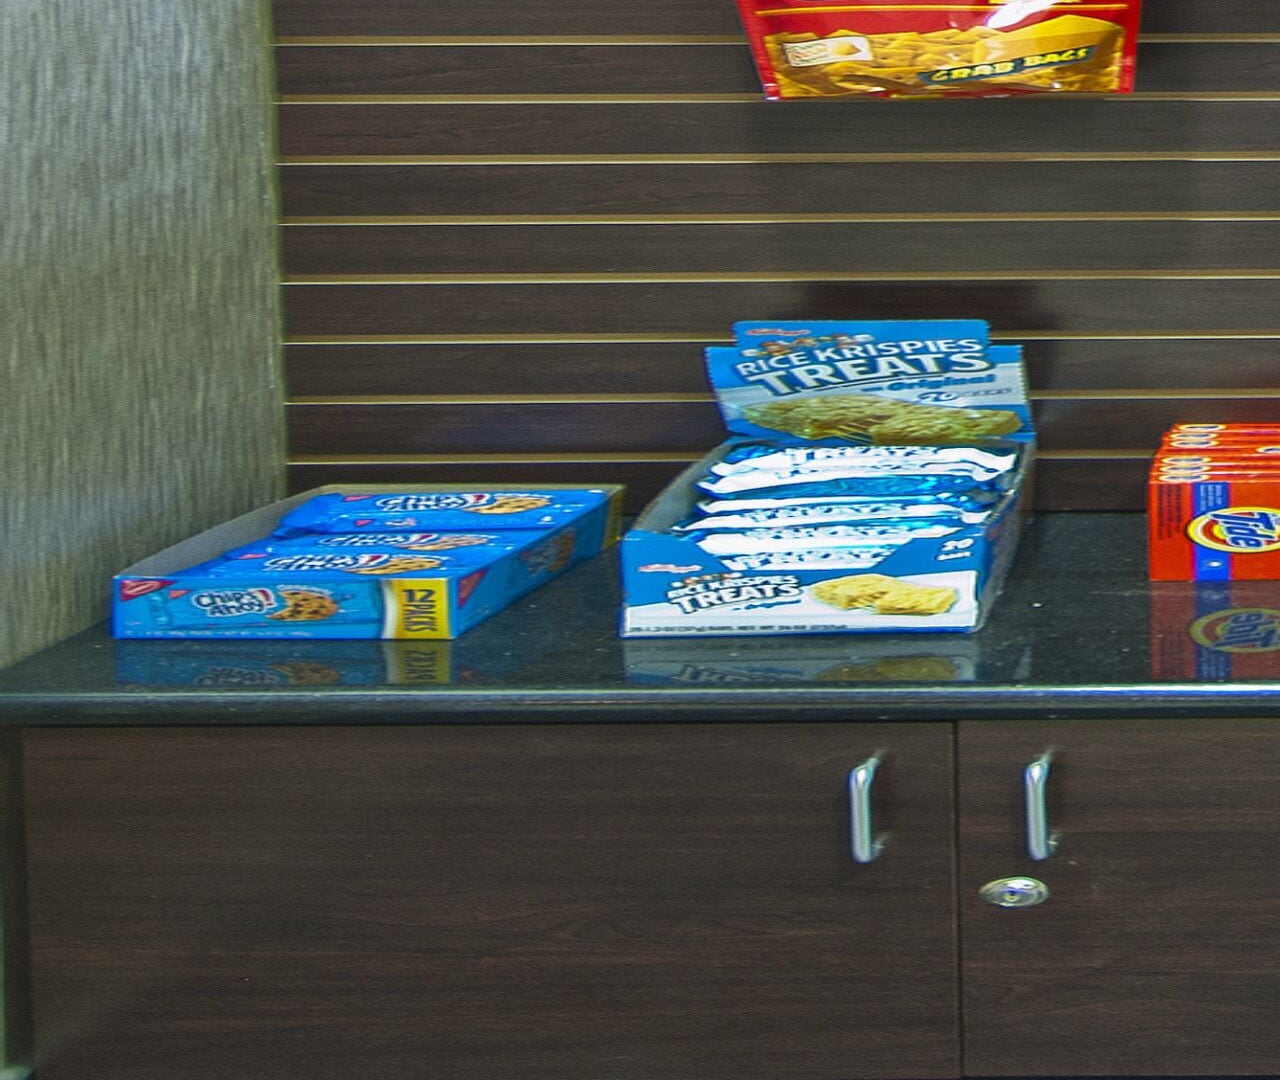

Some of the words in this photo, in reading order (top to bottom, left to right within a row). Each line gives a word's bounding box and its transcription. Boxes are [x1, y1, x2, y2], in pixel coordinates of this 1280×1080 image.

[735, 351, 811, 376] RICE
[813, 338, 985, 362] KRISPIES
[746, 352, 991, 398] TREATS
[1208, 511, 1278, 549] Tide
[401, 587, 436, 603] 12
[670, 584, 804, 614] TREATS
